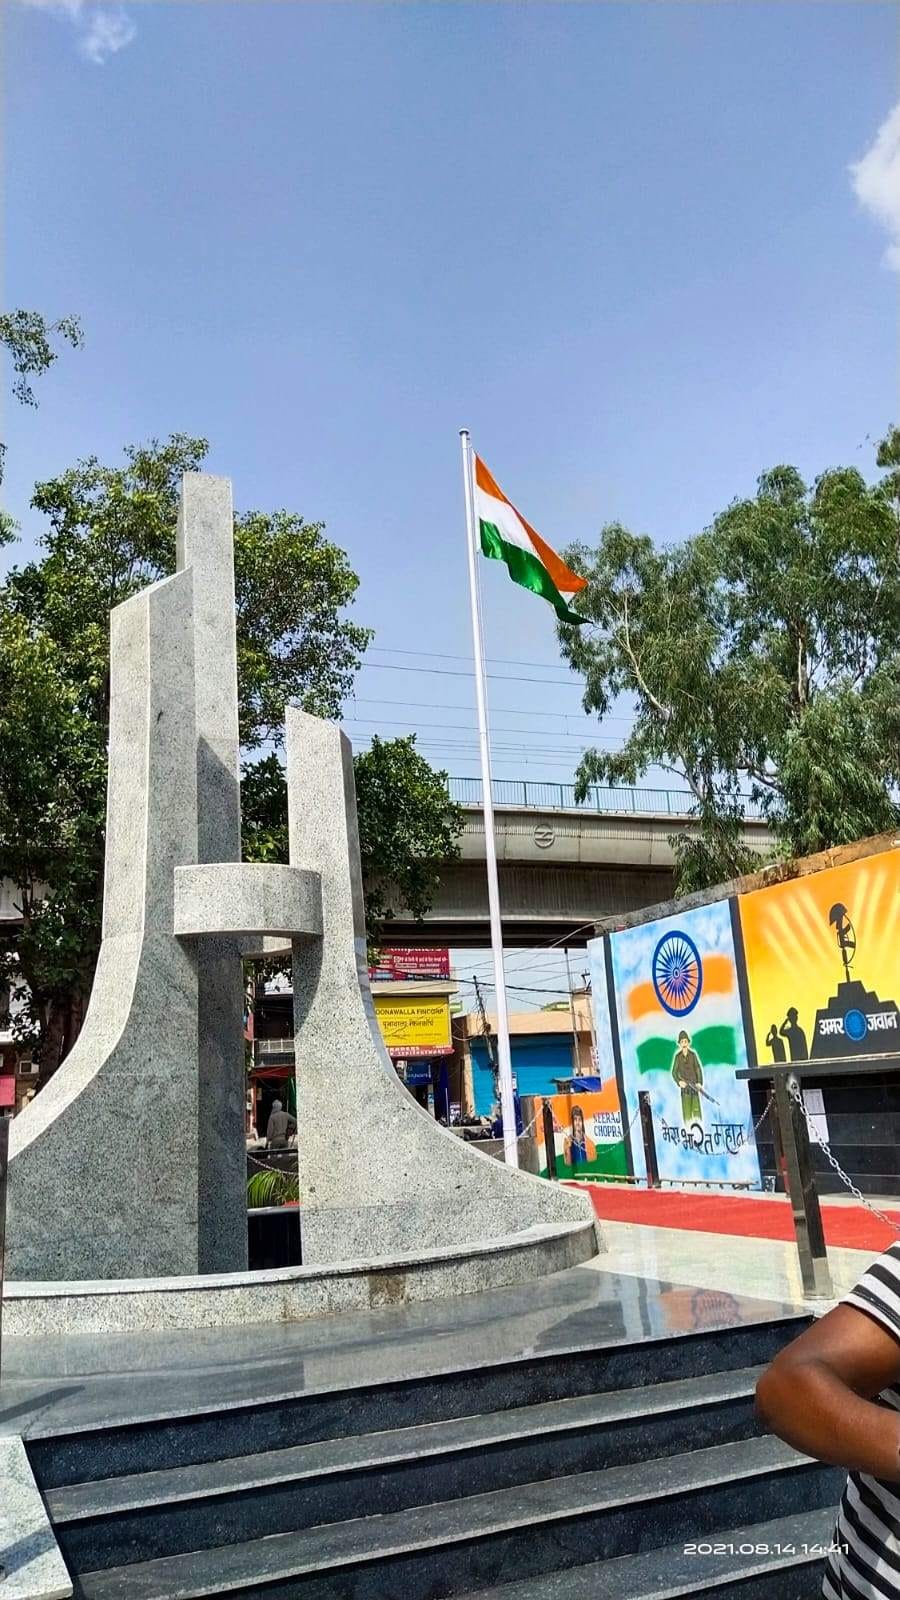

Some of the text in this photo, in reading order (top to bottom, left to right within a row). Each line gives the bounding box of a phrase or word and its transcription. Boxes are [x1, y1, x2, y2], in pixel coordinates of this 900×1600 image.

[376, 1007, 444, 1016] OONAWALLA FINCORP
[818, 1011, 898, 1035] अमर जवान
[592, 1111, 621, 1124] NEERAJ
[593, 1125, 623, 1138] CHOPRA
[661, 1118, 681, 1145] मेरा
[681, 1123, 713, 1154] भारत
